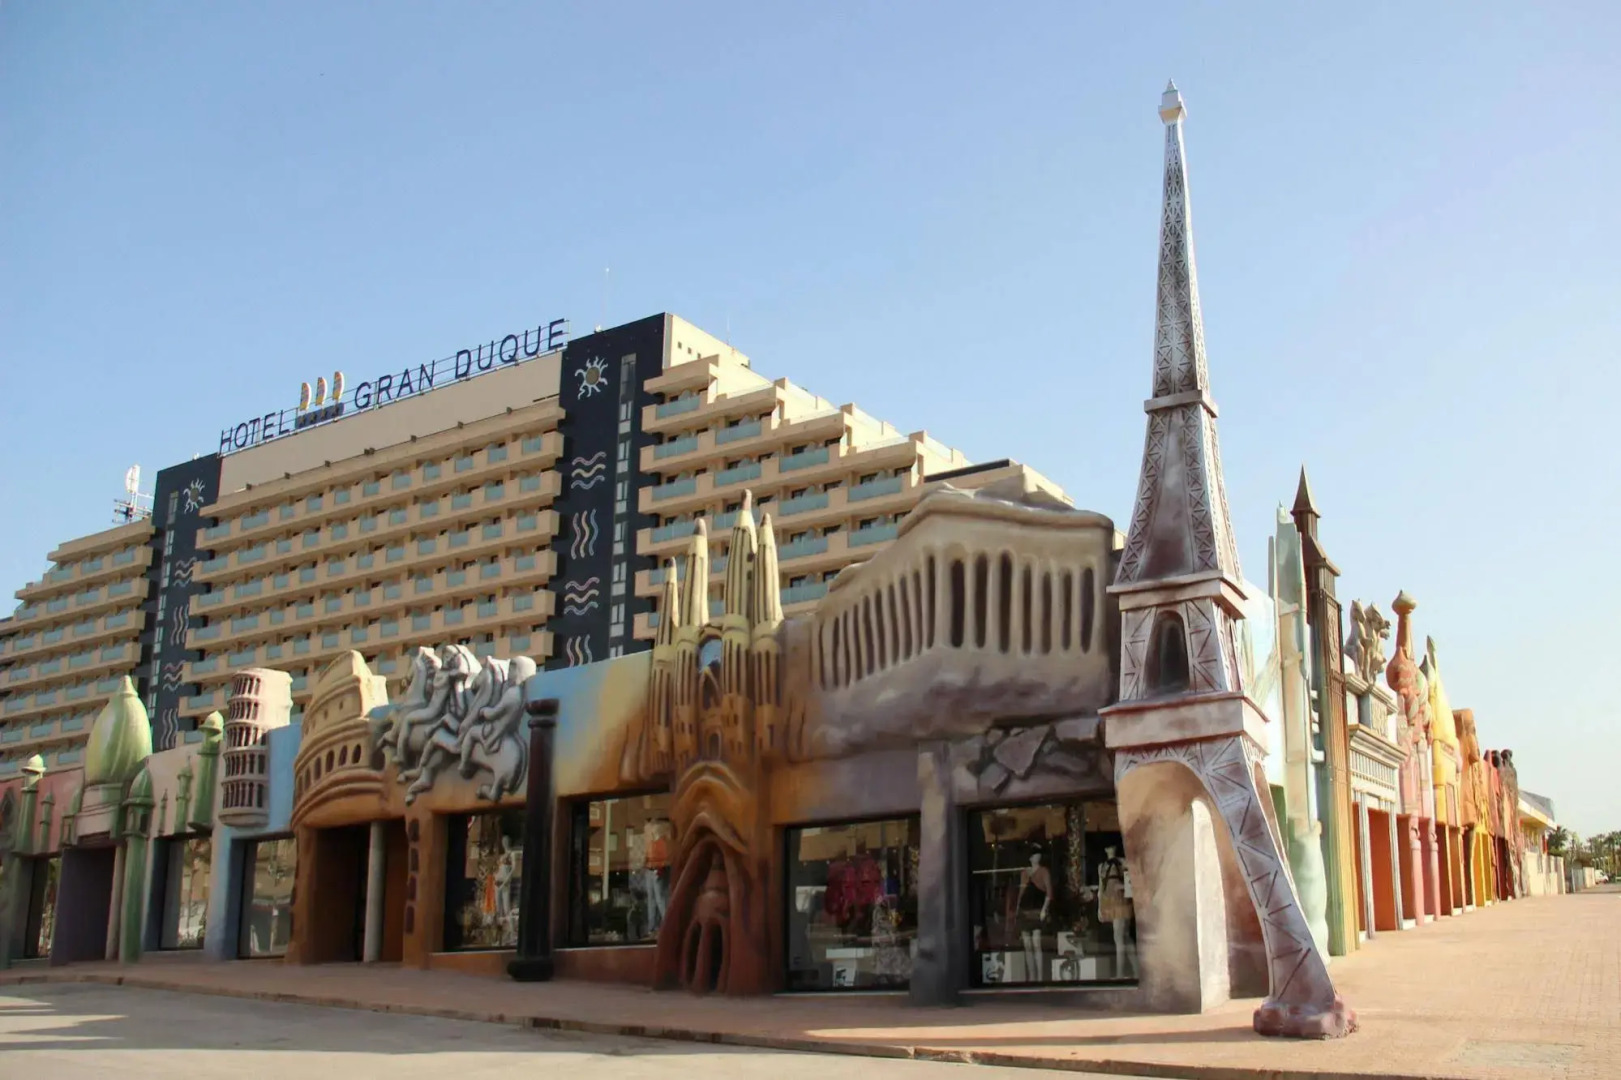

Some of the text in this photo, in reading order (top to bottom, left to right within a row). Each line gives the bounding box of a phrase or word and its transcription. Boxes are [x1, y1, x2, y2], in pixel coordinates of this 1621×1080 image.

[219, 318, 566, 454] HOTEL GRAN DUQUE
